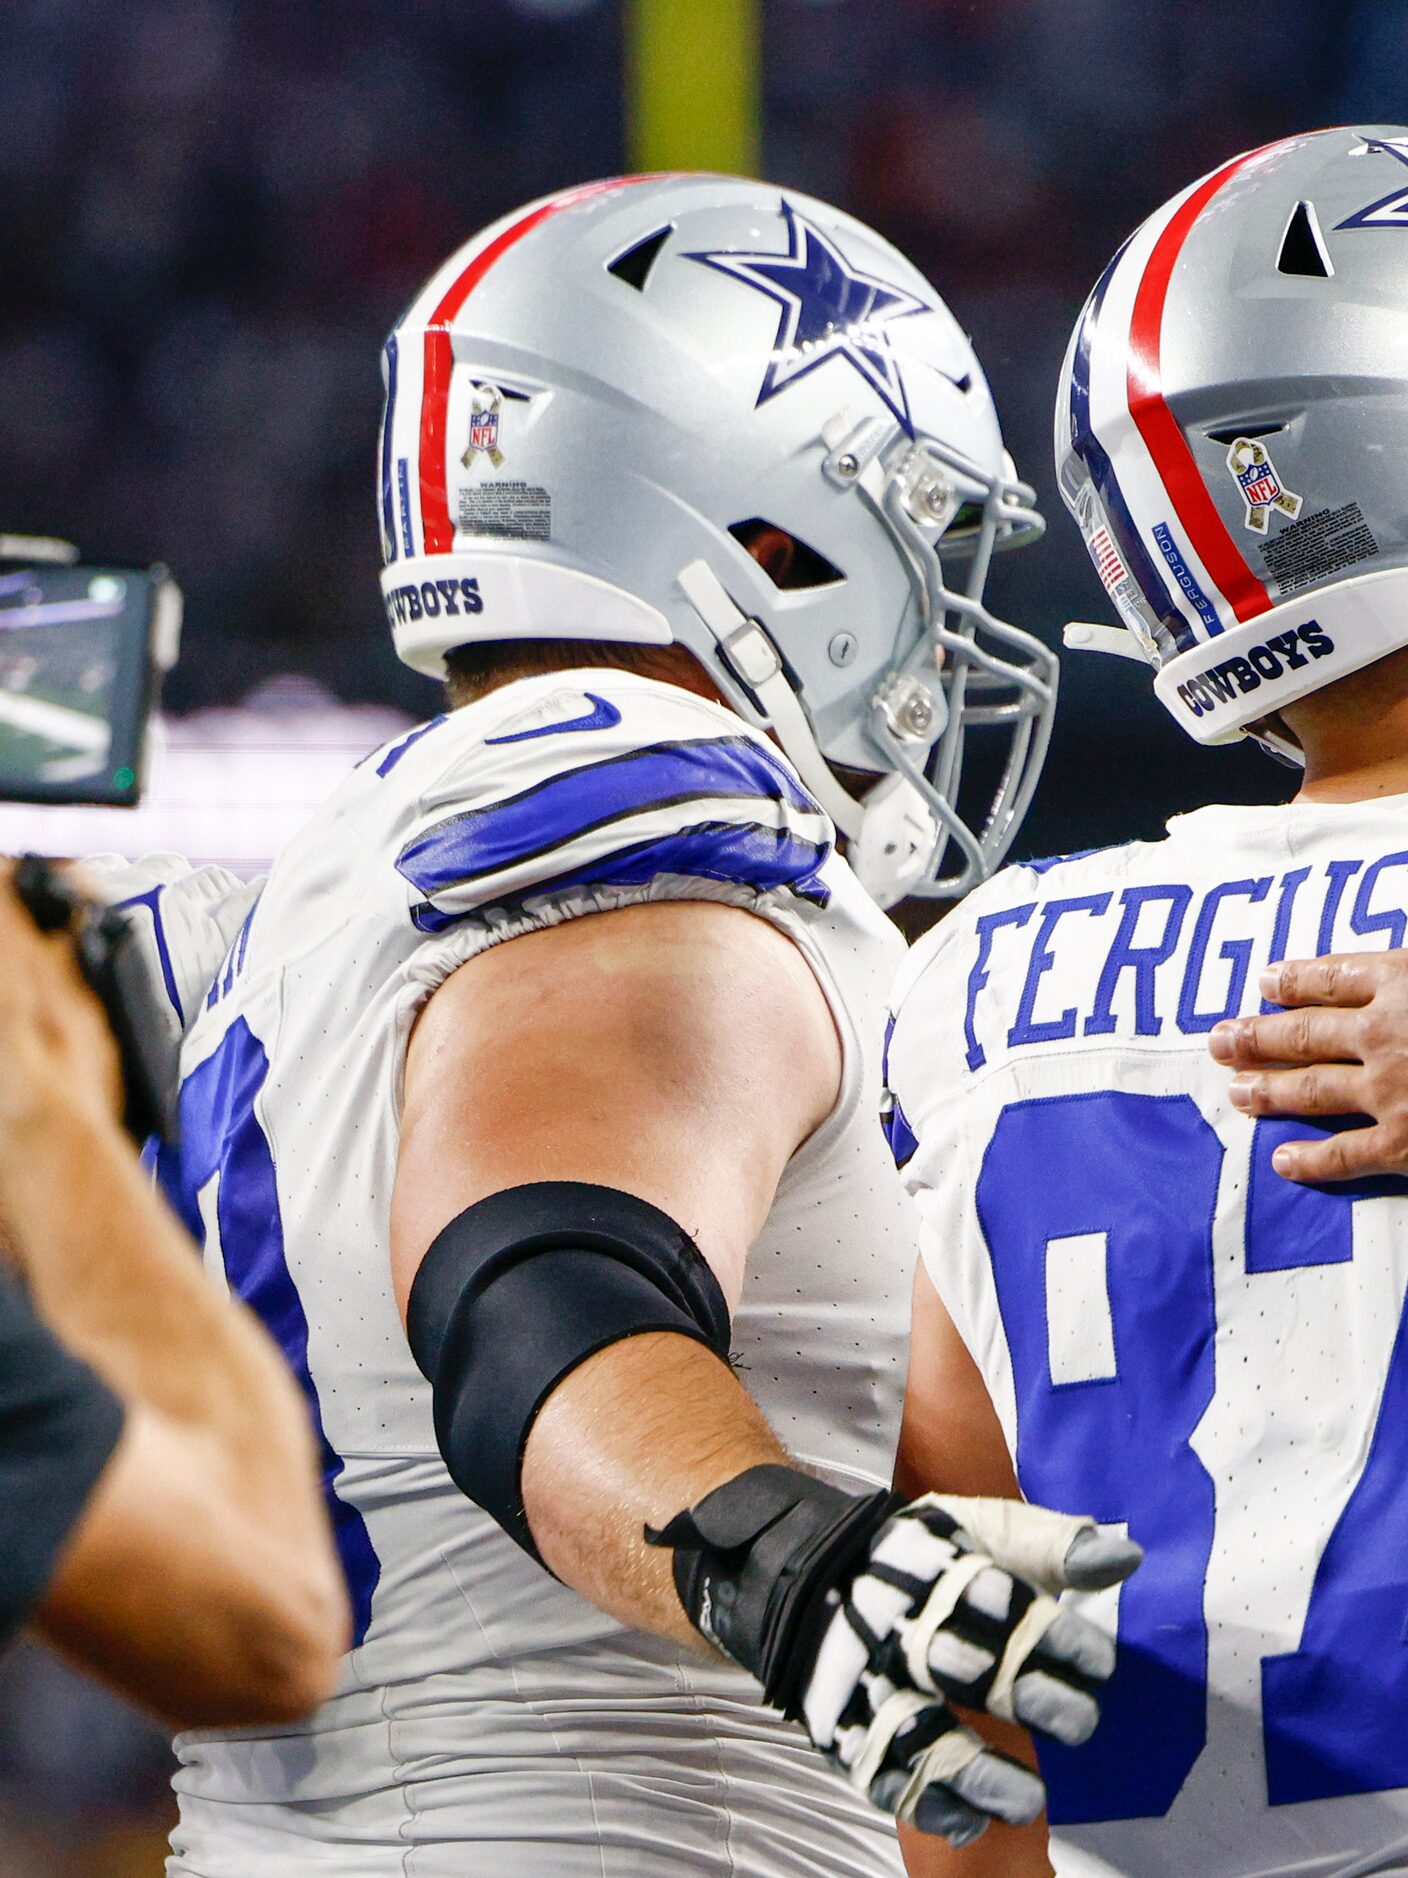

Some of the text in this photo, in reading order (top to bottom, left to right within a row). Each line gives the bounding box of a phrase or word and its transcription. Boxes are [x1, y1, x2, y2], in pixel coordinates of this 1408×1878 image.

[472, 426, 496, 447] NFL
[1246, 479, 1279, 504] NFL
[1279, 507, 1331, 534] WARNING
[1154, 526, 1216, 625] FERGUSON
[1177, 619, 1335, 718] COWBOYS
